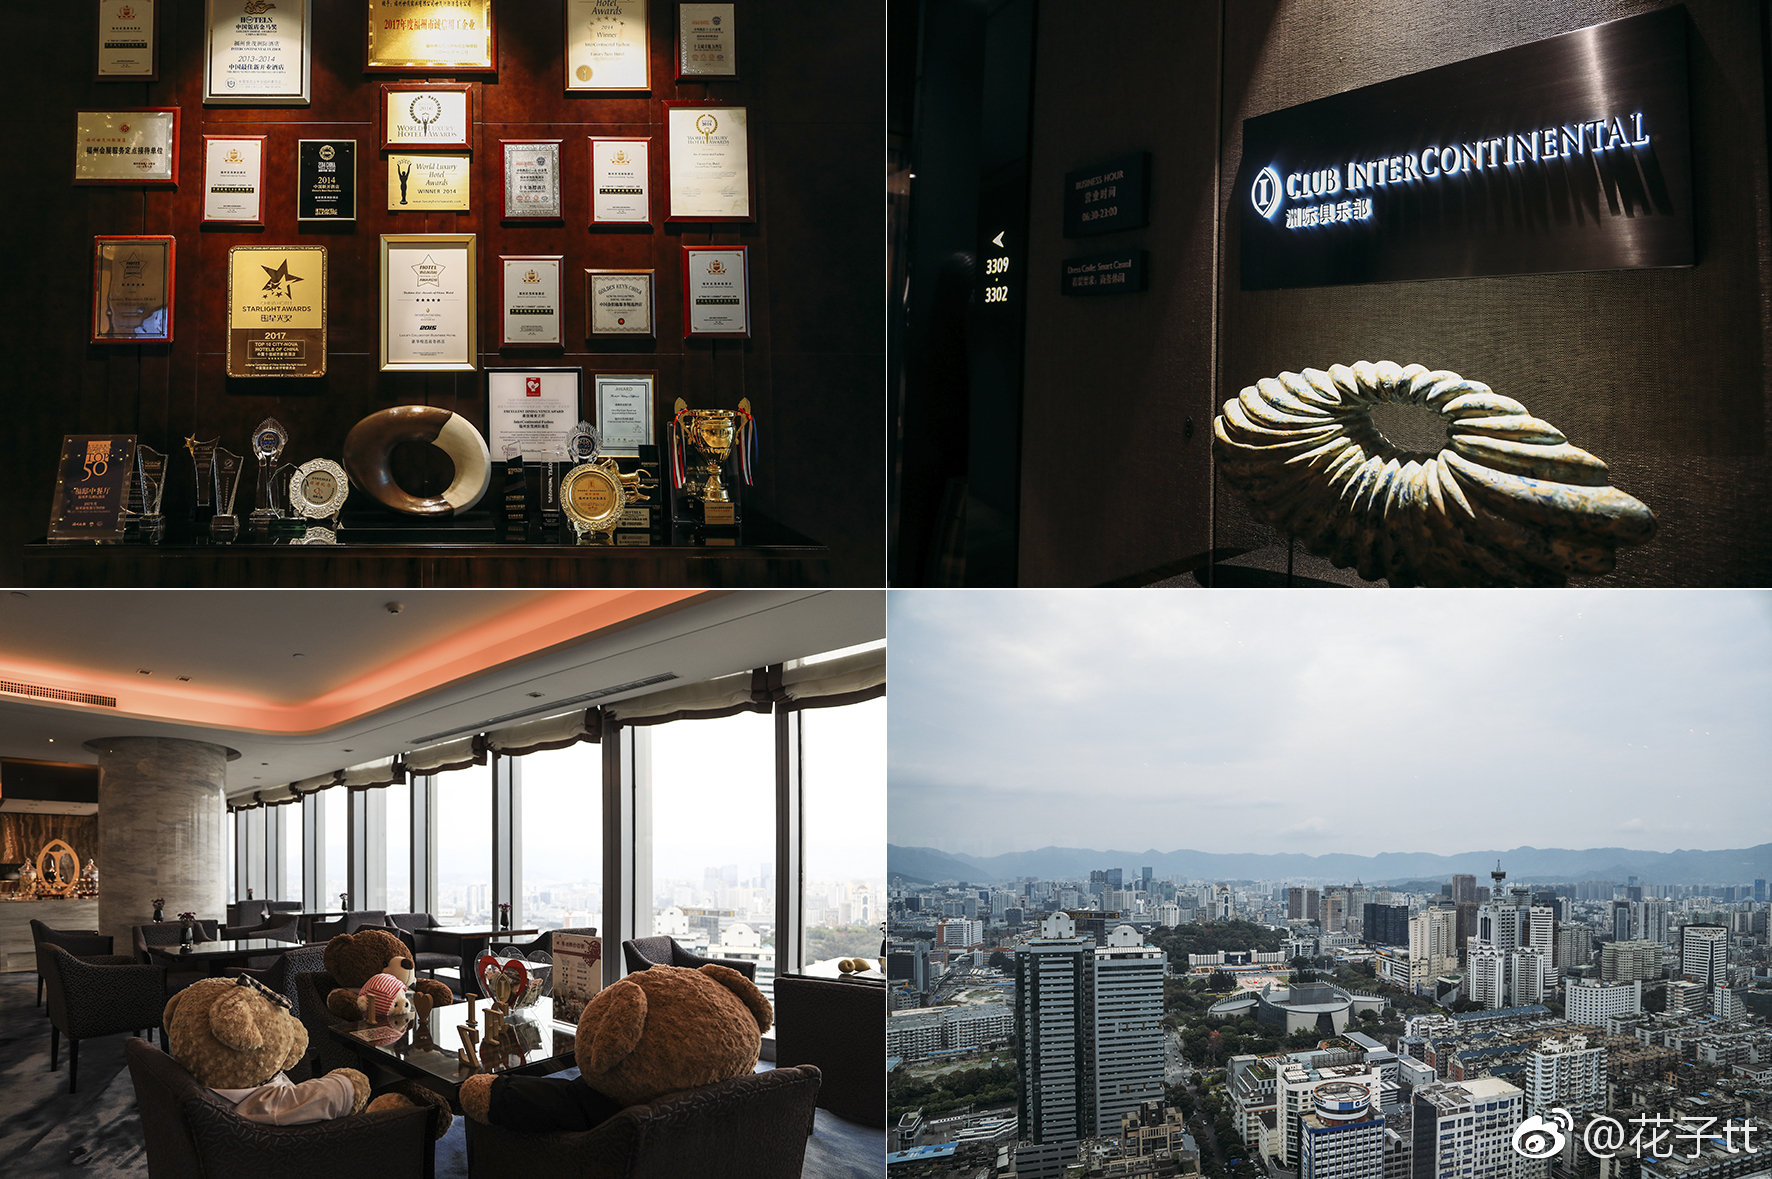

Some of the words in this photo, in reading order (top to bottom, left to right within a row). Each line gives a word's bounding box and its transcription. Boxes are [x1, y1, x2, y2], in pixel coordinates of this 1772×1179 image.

[591, 6, 622, 15] Awards
[1286, 168, 1341, 200] CLUB
[1344, 112, 1650, 191] INTERCONTINENTAL
[436, 164, 457, 172] Luxury
[1075, 176, 1102, 190] BUSINESS
[1104, 170, 1124, 183] HOUR
[1084, 186, 1116, 204] 营业时间
[1082, 206, 1118, 222] 06:30-23:00
[1284, 198, 1372, 230] 洲际俱乐部
[986, 256, 1010, 275] 3309
[1067, 266, 1081, 274] Dress
[1098, 262, 1113, 271] Smart
[1113, 259, 1132, 270] Casual
[985, 286, 1008, 303] 3302
[87, 453, 110, 462] TOP
[82, 460, 108, 481] 50
